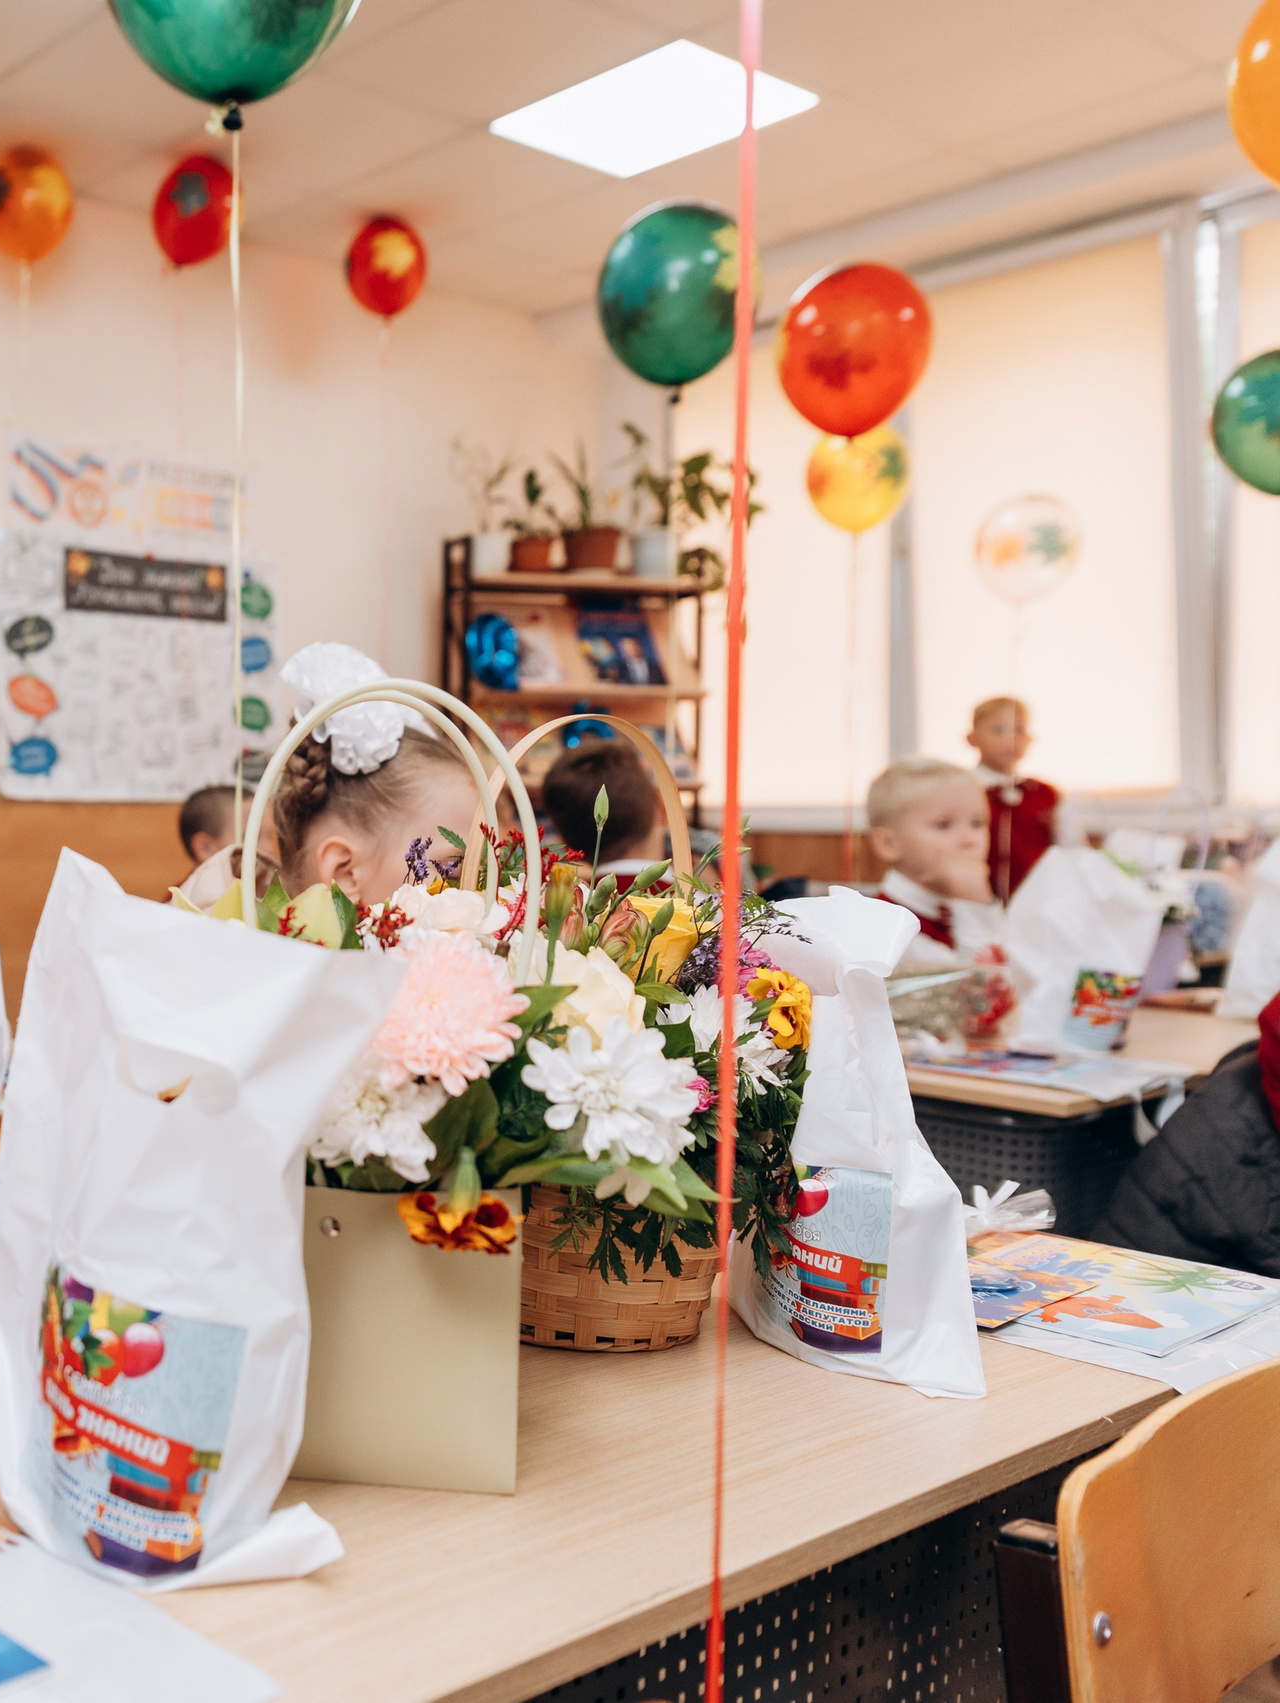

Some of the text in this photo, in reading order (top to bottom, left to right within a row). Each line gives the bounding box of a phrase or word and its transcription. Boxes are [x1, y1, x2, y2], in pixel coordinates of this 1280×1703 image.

[778, 1300, 835, 1332] ЧАХОВСКИЙ
[788, 1289, 873, 1319] ПОЖЕЛАНИЯМИ,
[801, 1306, 870, 1328] ДЕПУТАТОВ
